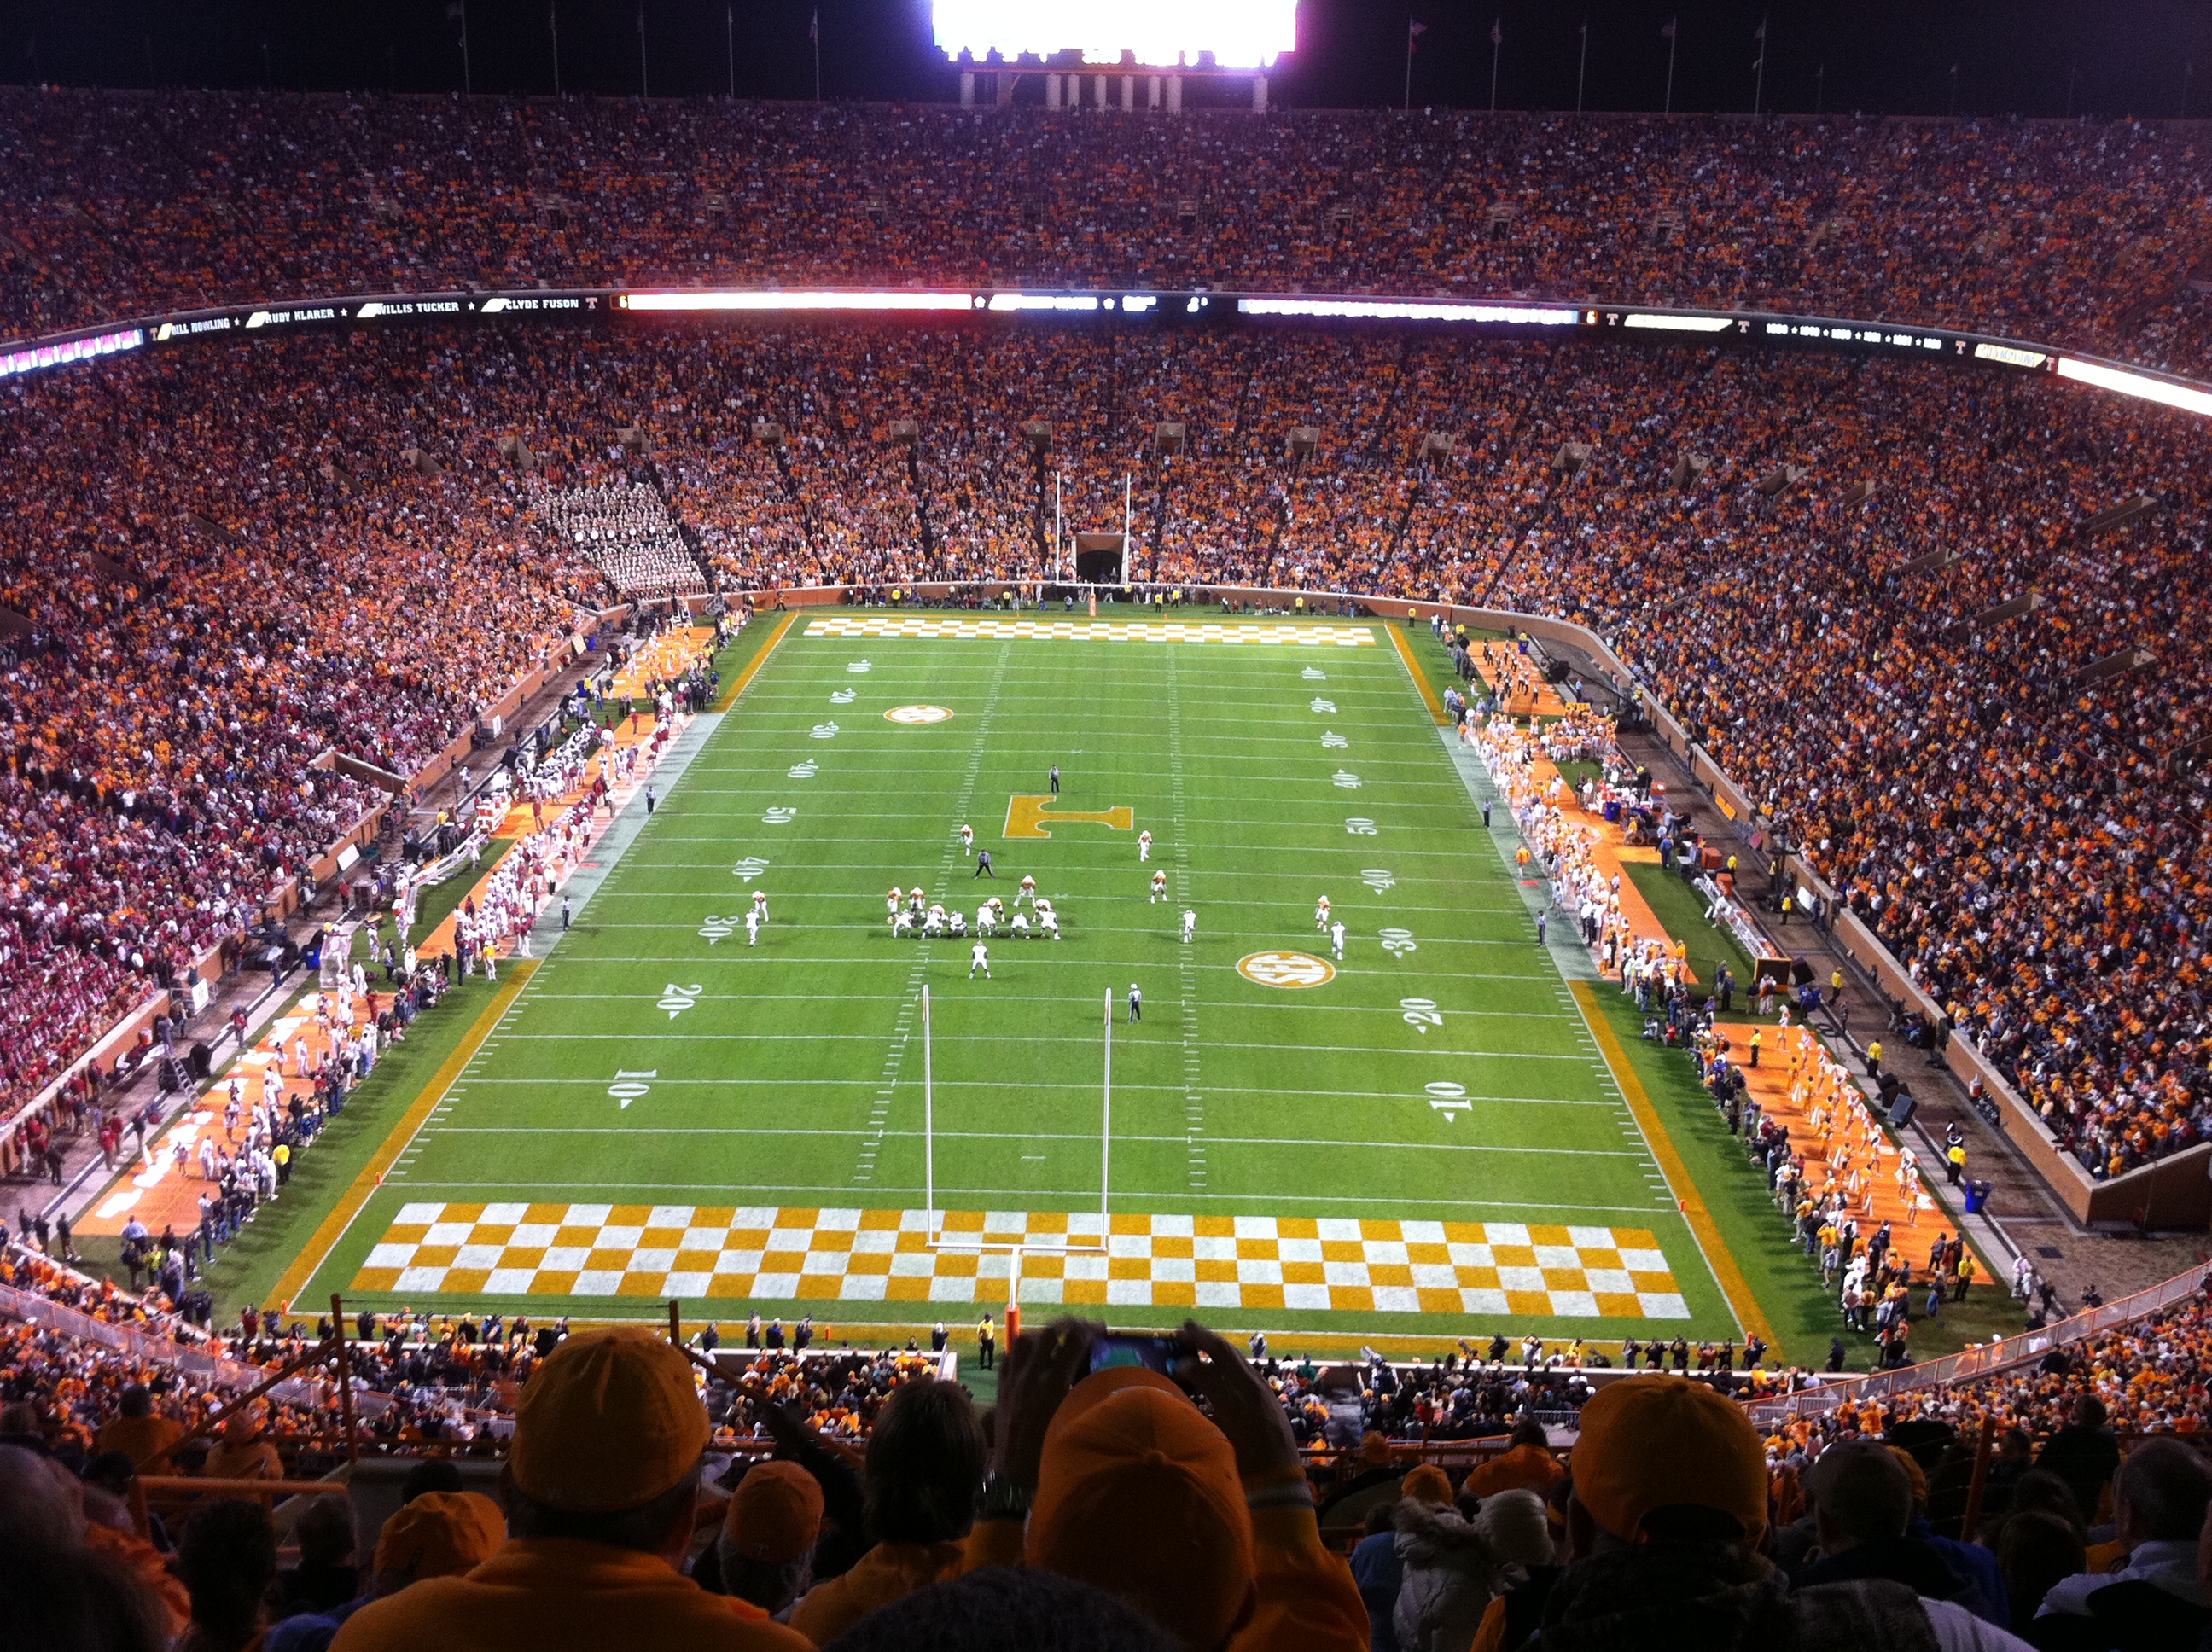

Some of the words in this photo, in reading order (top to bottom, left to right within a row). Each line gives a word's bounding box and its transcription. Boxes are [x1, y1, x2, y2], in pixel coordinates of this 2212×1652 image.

[378, 304, 414, 315] WILLIS
[416, 302, 459, 313] TUCKER
[506, 300, 538, 310] CLYDE
[543, 299, 579, 309] FUSON
[265, 311, 290, 324] RUDY
[294, 308, 335, 321] KLARER
[829, 691, 857, 703] 20
[1310, 701, 1337, 713] 20
[809, 724, 840, 738] 30
[1320, 735, 1348, 748] 30
[787, 763, 819, 778] 40
[1332, 773, 1362, 788] 40
[761, 806, 797, 823] 50
[1345, 817, 1377, 835] 50
[731, 856, 770, 876] 40
[1360, 869, 1395, 888] 40
[697, 915, 739, 937] 30
[1378, 928, 1417, 951] 30
[656, 983, 703, 1010] 20
[1399, 998, 1443, 1025] 20
[607, 1068, 657, 1097] 10
[1424, 1081, 1473, 1110] 10
